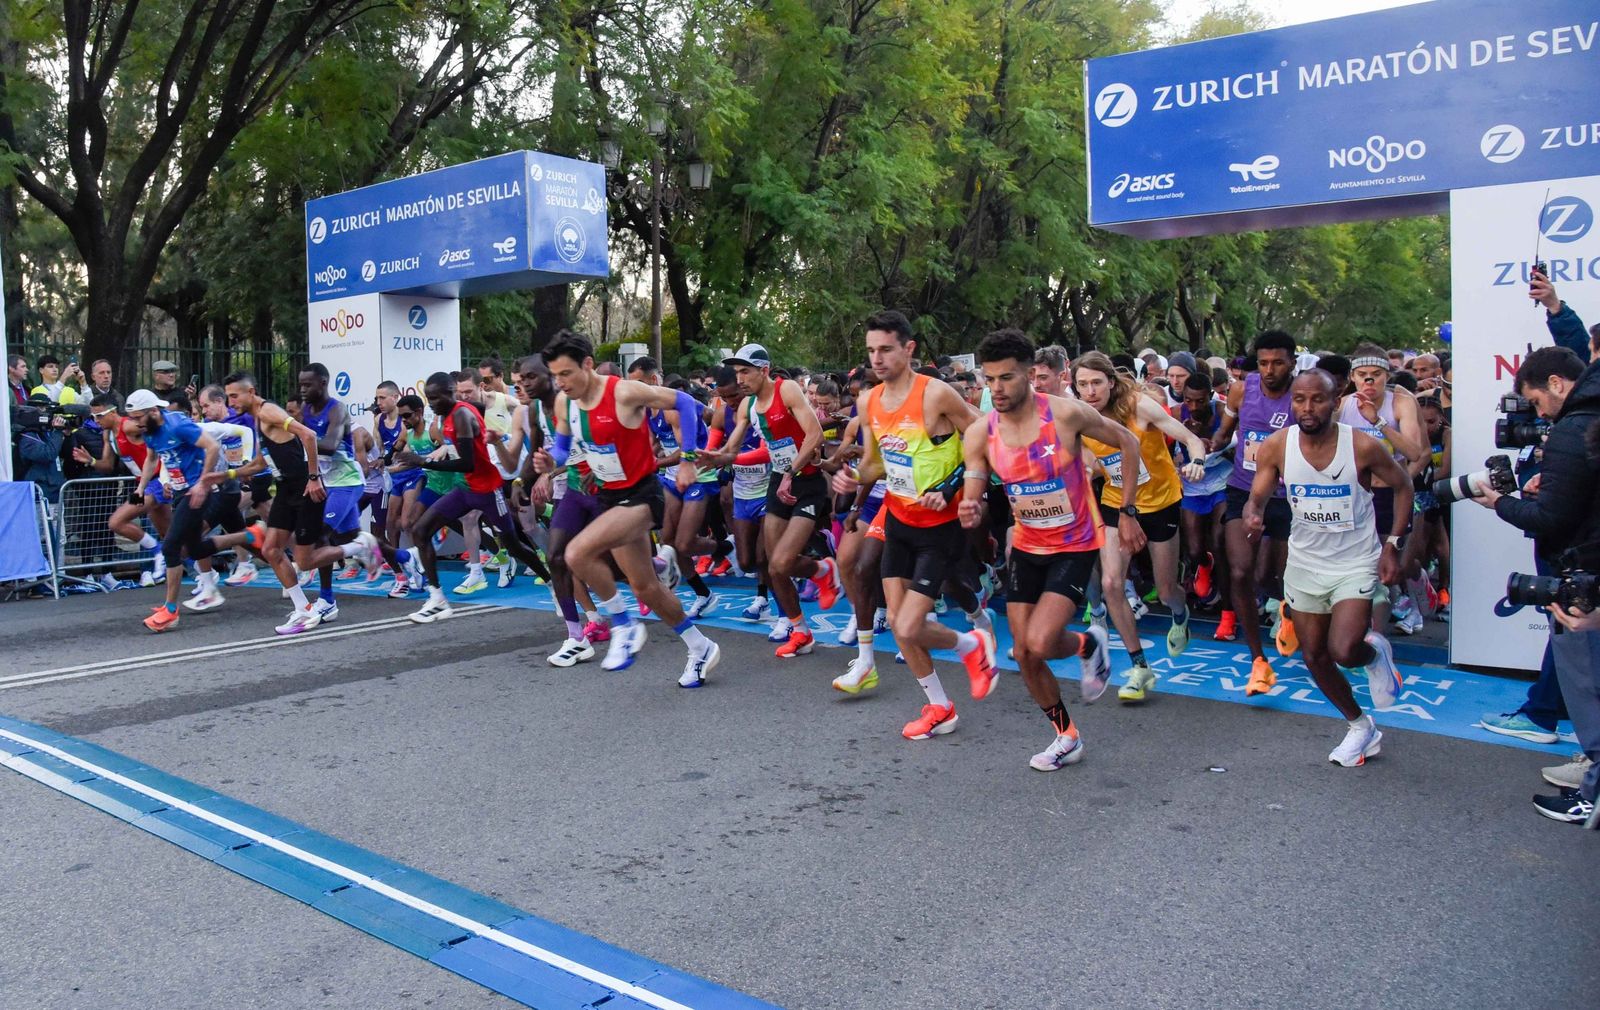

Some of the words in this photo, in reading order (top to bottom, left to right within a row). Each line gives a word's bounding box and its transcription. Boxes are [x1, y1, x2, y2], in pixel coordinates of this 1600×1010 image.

[1152, 70, 1279, 111] ZURICH
[1299, 41, 1457, 91] MARATÓN
[1470, 34, 1516, 67] DE
[1527, 22, 1599, 58] SEV
[546, 170, 577, 183] ZURICH
[1386, 177, 1397, 185] DE
[1230, 182, 1280, 194] TotalEnergies
[332, 210, 380, 234] ZURICH
[386, 194, 444, 223] MARATÓN
[448, 192, 464, 210] DE
[467, 181, 520, 205] SEVILLA
[545, 195, 579, 209] SEVILLA
[380, 256, 420, 275] ZURICH
[393, 337, 444, 351] ZURICH
[1024, 482, 1056, 493] ZURICH
[1020, 505, 1064, 518] KHADIRI
[1304, 512, 1340, 522] ASRAR
